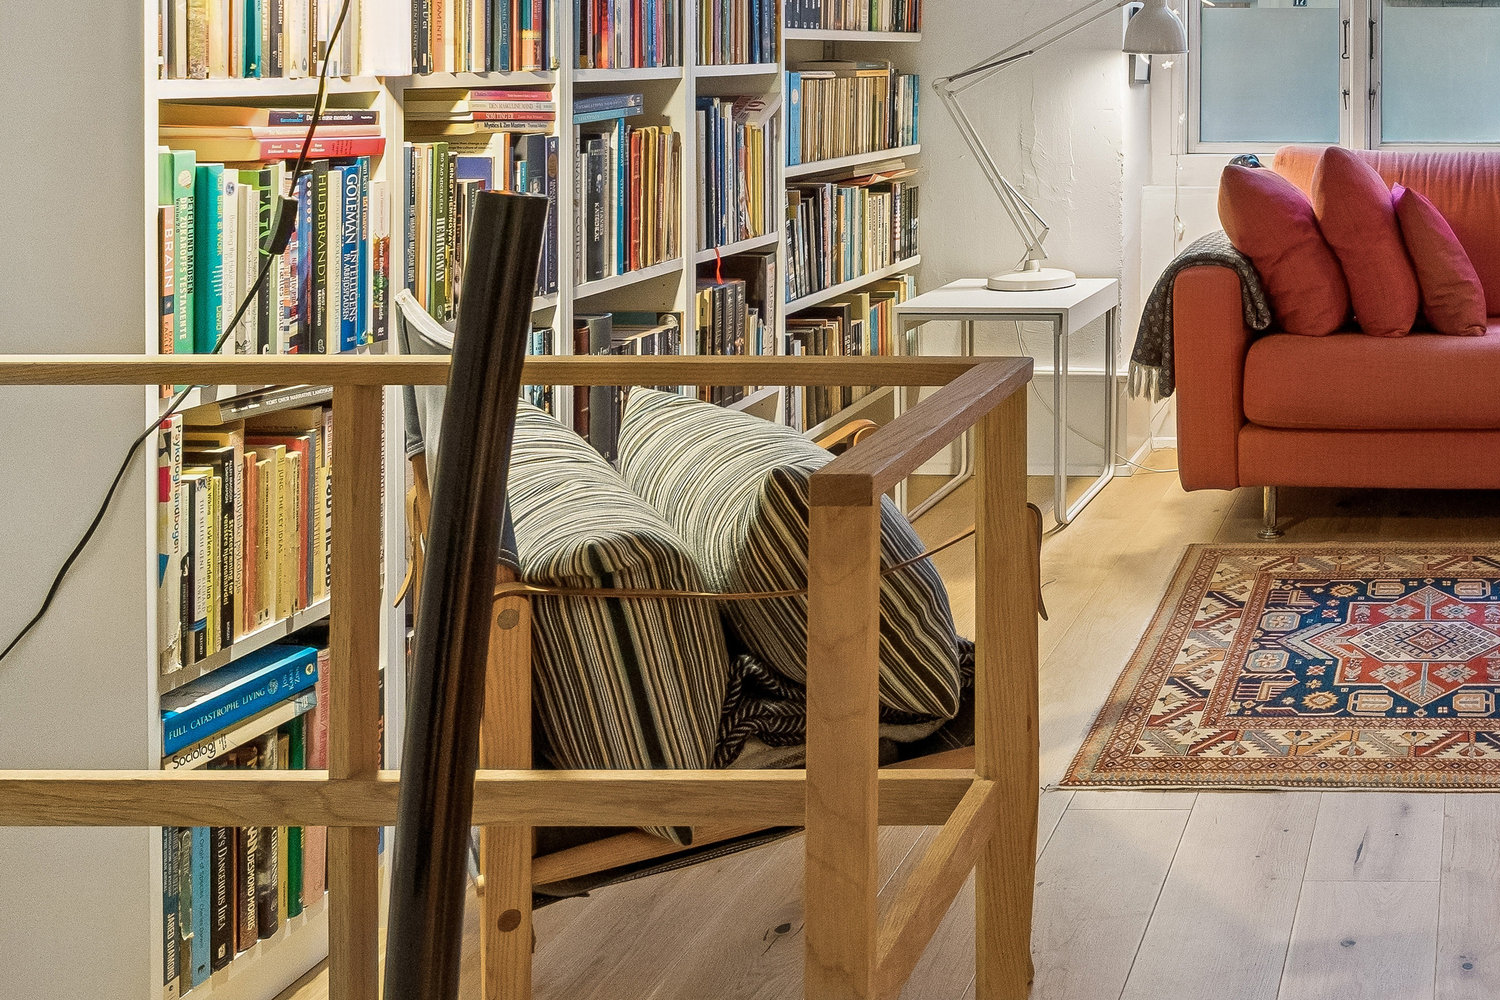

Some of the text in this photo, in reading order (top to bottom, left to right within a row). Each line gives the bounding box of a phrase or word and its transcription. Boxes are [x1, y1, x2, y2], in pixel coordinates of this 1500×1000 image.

[318, 174, 326, 285] HILDEBRANDT
[344, 174, 358, 244] GOLEMAN
[165, 228, 173, 288] BRAIN
[436, 217, 446, 282] HEMINGWAY
[168, 688, 266, 740] FULL CATASTROPHE LIVING
[217, 846, 228, 931] DANGEROUS IDEA
[247, 855, 255, 931] DESMOND MORRIS
[167, 913, 175, 940] JARED
